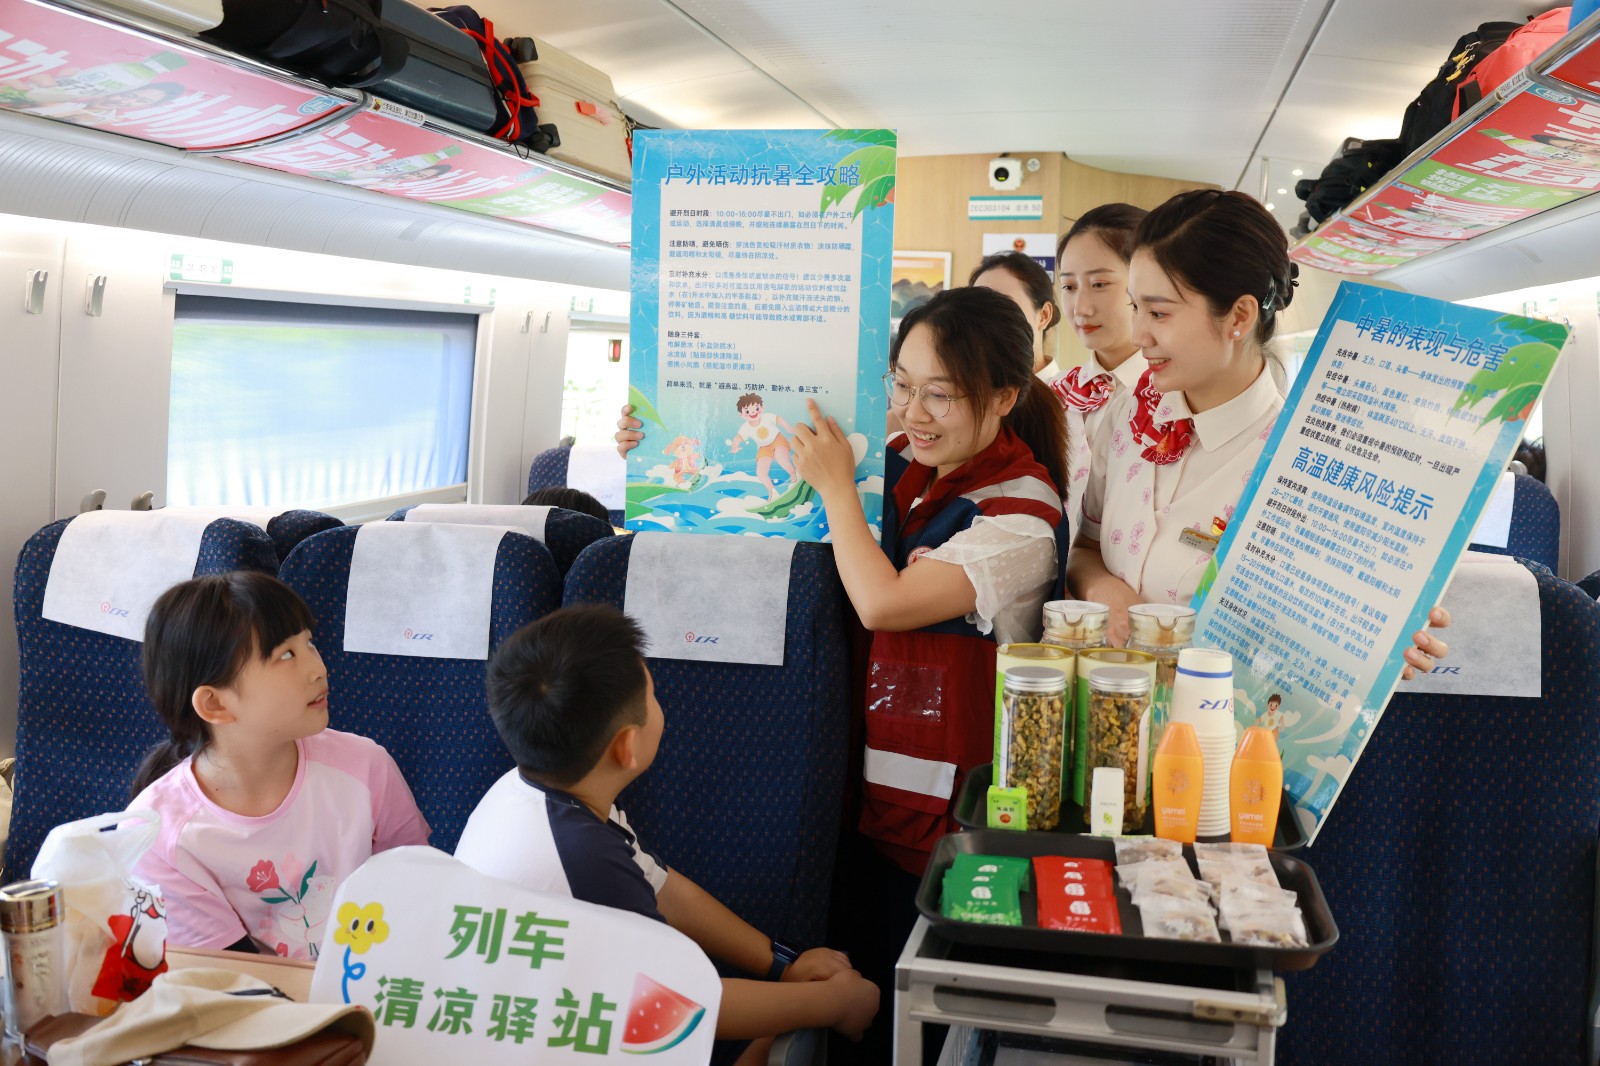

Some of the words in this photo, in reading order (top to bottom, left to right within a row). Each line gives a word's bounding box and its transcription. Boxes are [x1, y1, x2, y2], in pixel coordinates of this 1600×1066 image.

[665, 163, 861, 187] 户外活动抗暑全攻略
[1354, 312, 1510, 374] 中暑的表现与危害
[1290, 446, 1435, 522] 高温健康风险提示
[443, 904, 569, 970] 列车
[374, 975, 617, 1055] 清凉驿站
